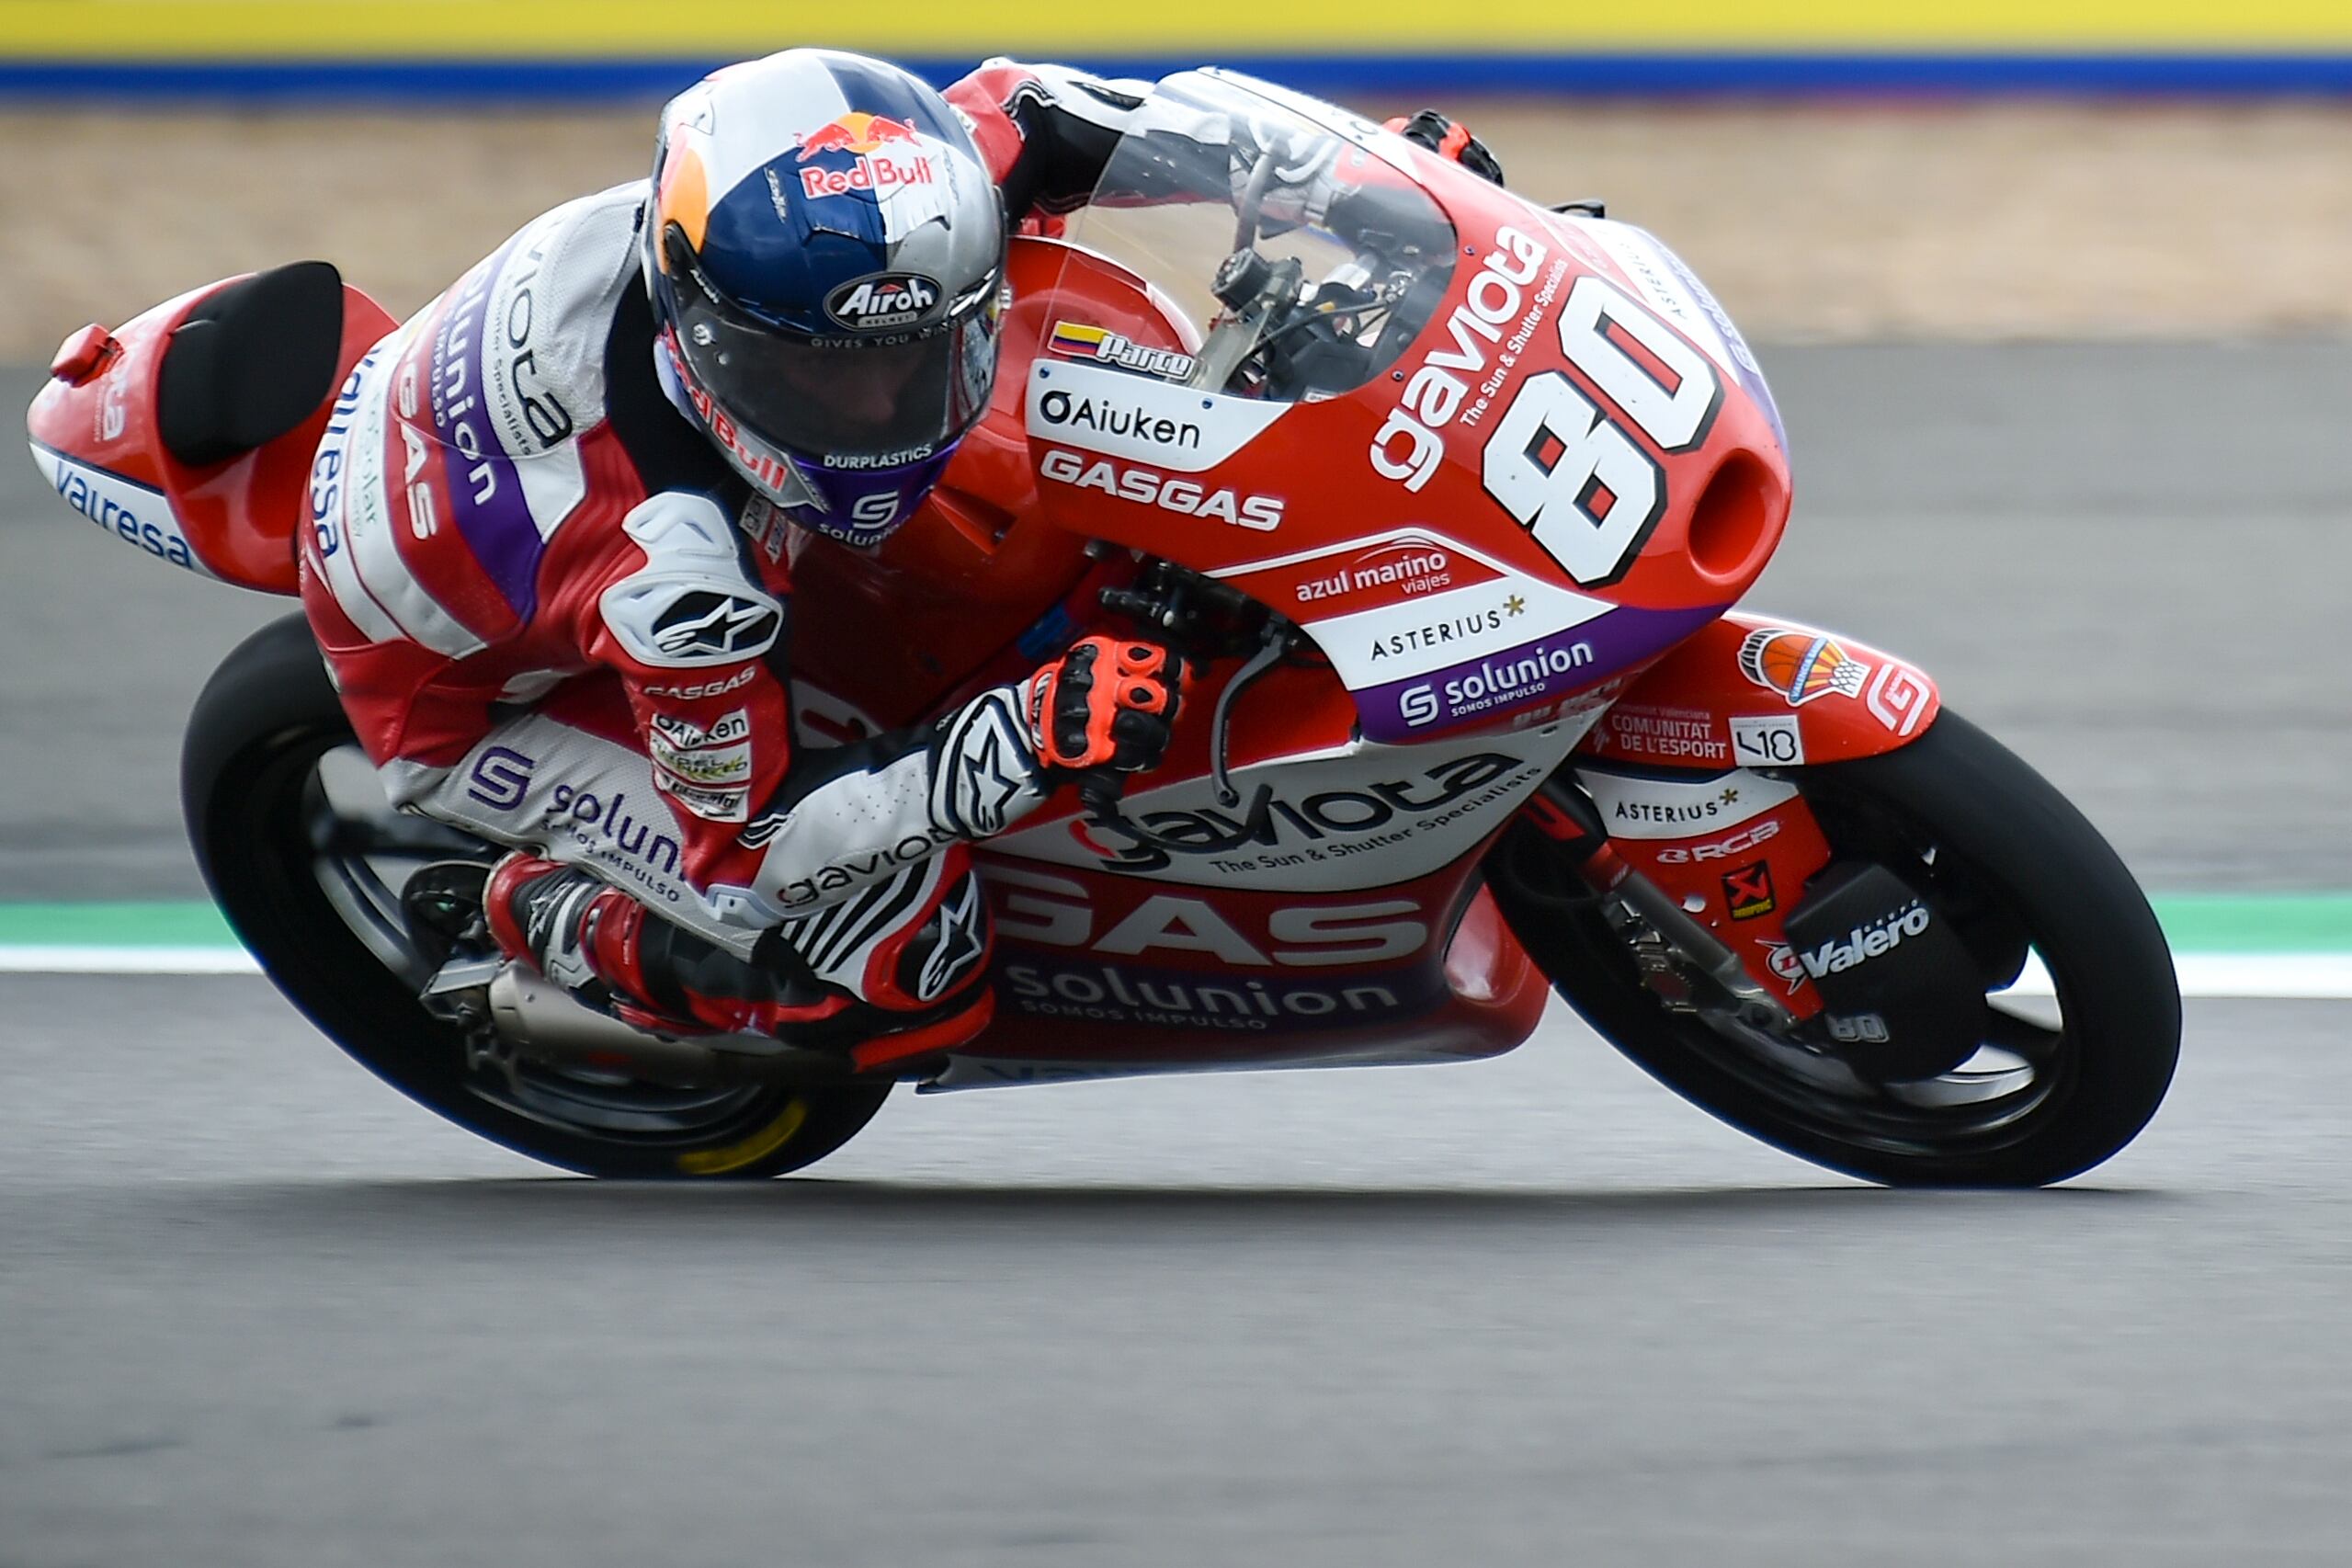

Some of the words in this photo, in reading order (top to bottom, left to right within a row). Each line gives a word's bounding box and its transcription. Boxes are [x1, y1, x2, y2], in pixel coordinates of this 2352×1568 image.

[799, 157, 872, 199] Red
[873, 157, 933, 186] Bull
[835, 278, 934, 316] Airoh
[811, 337, 862, 348] GIVES
[874, 334, 909, 346] YOU
[1506, 303, 1544, 356] Shutter
[1369, 222, 1551, 494] gaviota
[1498, 353, 1517, 369] &
[1480, 368, 1508, 398] Sun
[1459, 396, 1489, 427] The
[1482, 275, 1724, 585] 80
[711, 409, 789, 493] Bull
[824, 444, 933, 470] DURPLASTICS
[1040, 449, 1285, 532] GASGAS
[1296, 574, 1350, 601] azul
[1353, 552, 1448, 588] marino
[1402, 573, 1451, 595] viajes
[1370, 609, 1501, 662] ASTERIUS
[1445, 642, 1595, 705] solunion
[1450, 699, 1493, 718] SOMOS
[1494, 682, 1546, 706] IMPULSO
[1611, 714, 1712, 740] COMUNITAT
[1619, 733, 1643, 753] DE
[1645, 736, 1727, 760] L'ESPORT
[546, 784, 688, 882] solun
[1210, 858, 1256, 875] The
[1260, 853, 1303, 869] Sun
[1306, 847, 1326, 862] &
[1327, 826, 1414, 858] Shutter
[1417, 766, 1542, 832] Specialists
[1615, 801, 1719, 824] ASTERIUS
[600, 850, 680, 903] IMPULSO
[1007, 965, 1400, 1017] solunion
[1020, 998, 1124, 1022] SOMOS
[1134, 1009, 1268, 1030] IMPULSO
